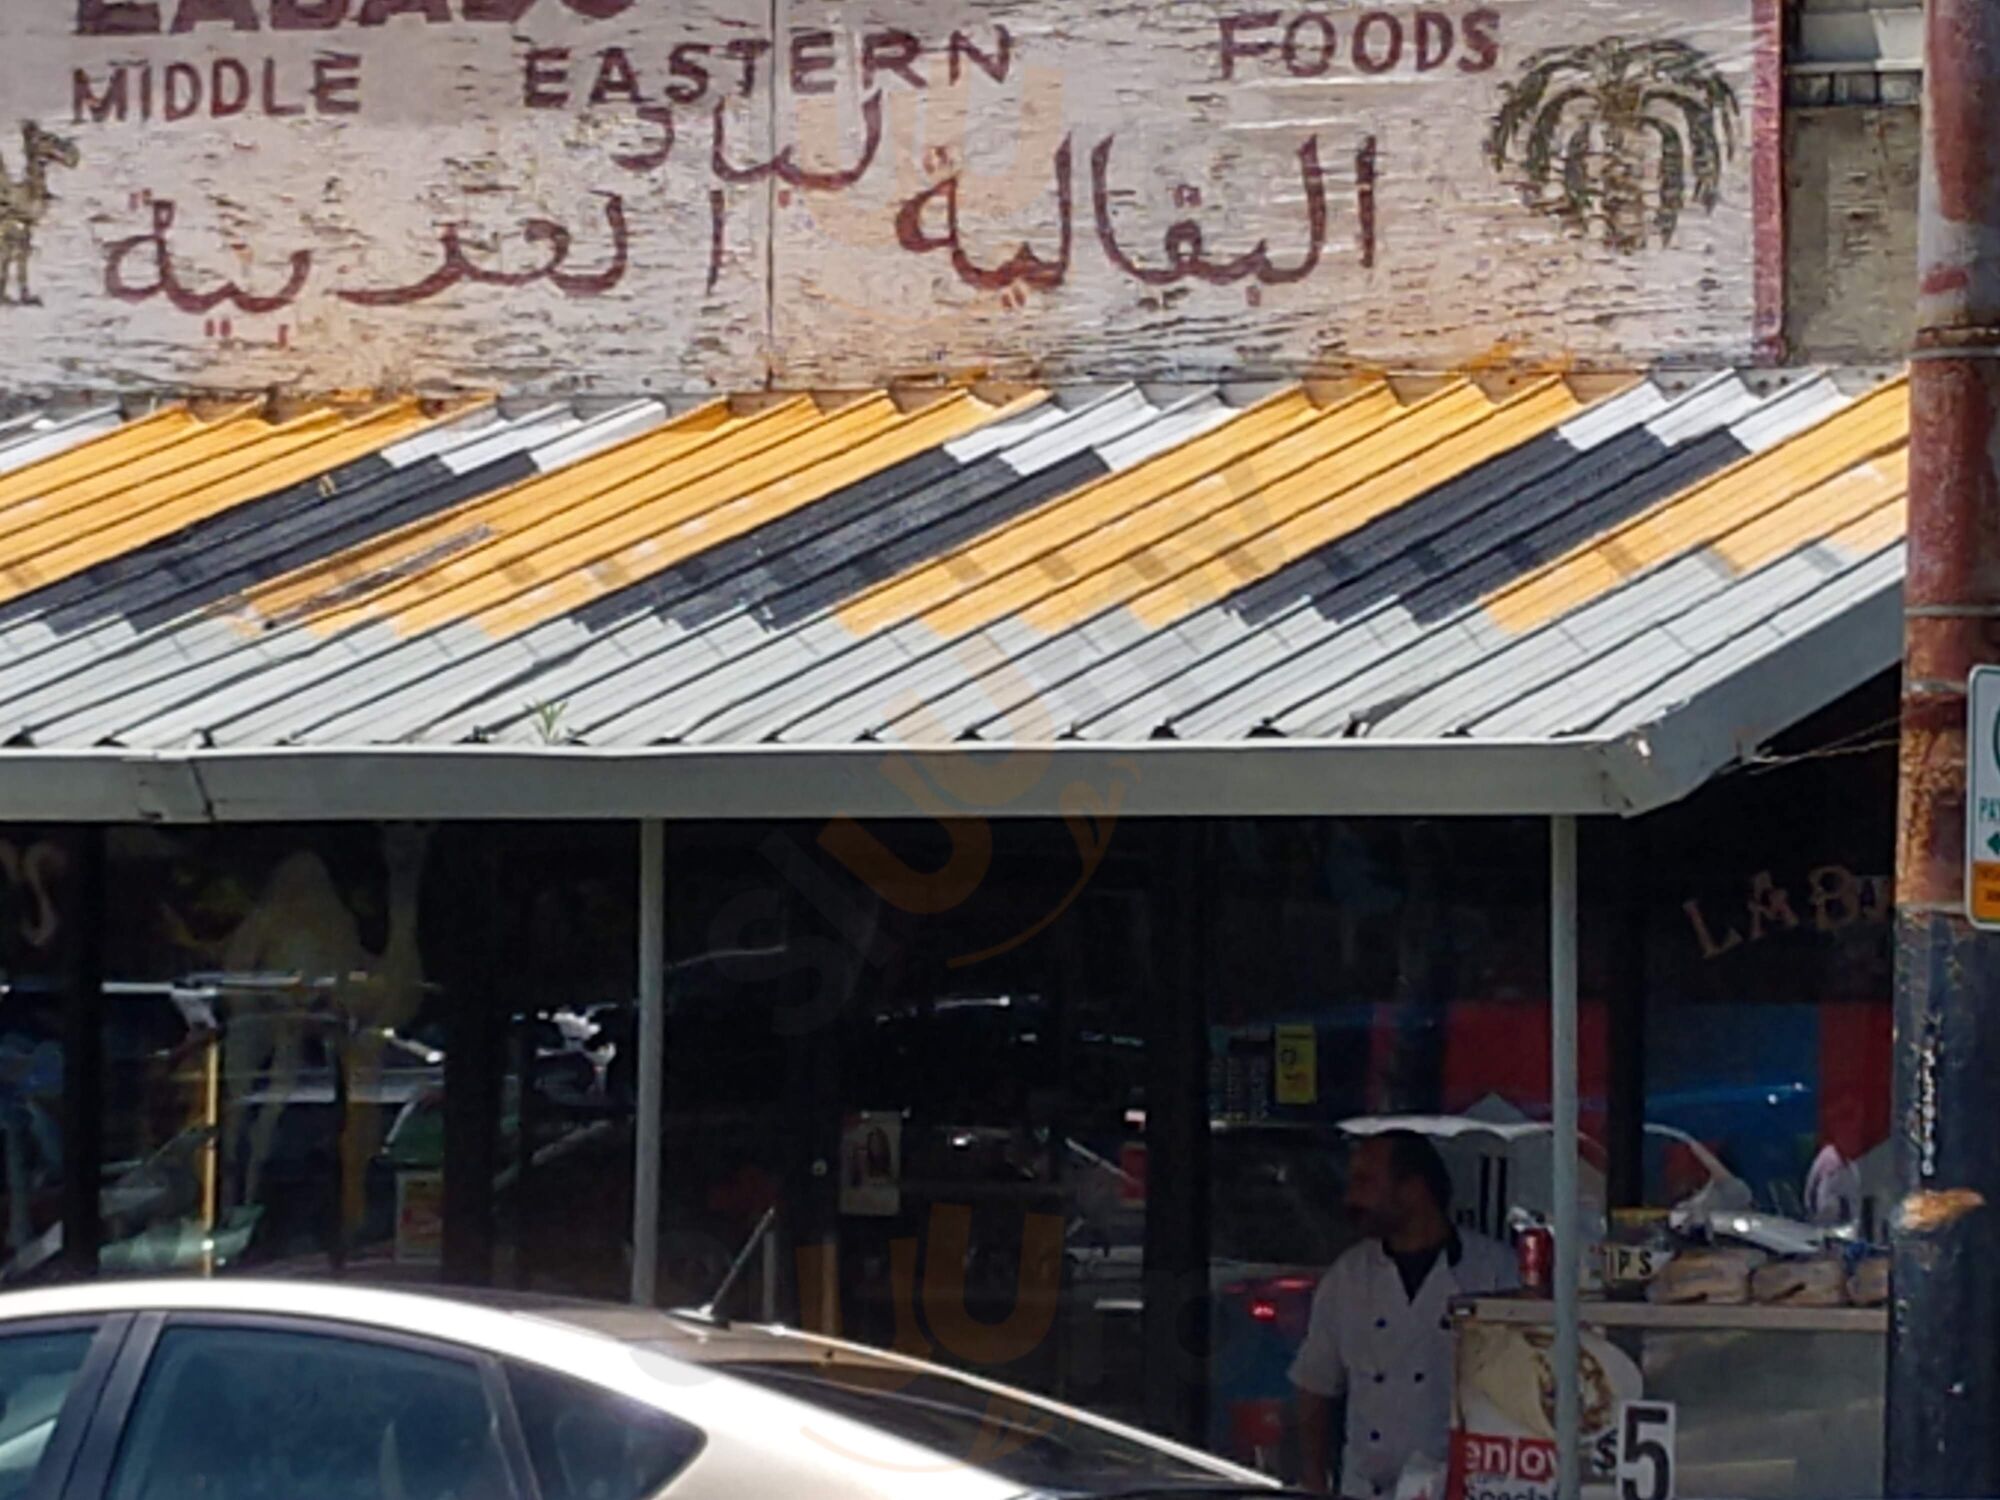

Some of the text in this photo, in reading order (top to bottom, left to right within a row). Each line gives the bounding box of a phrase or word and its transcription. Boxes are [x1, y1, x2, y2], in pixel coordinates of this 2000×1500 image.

[72, 9, 1502, 122] MIDDLE EASTERN FOODS
